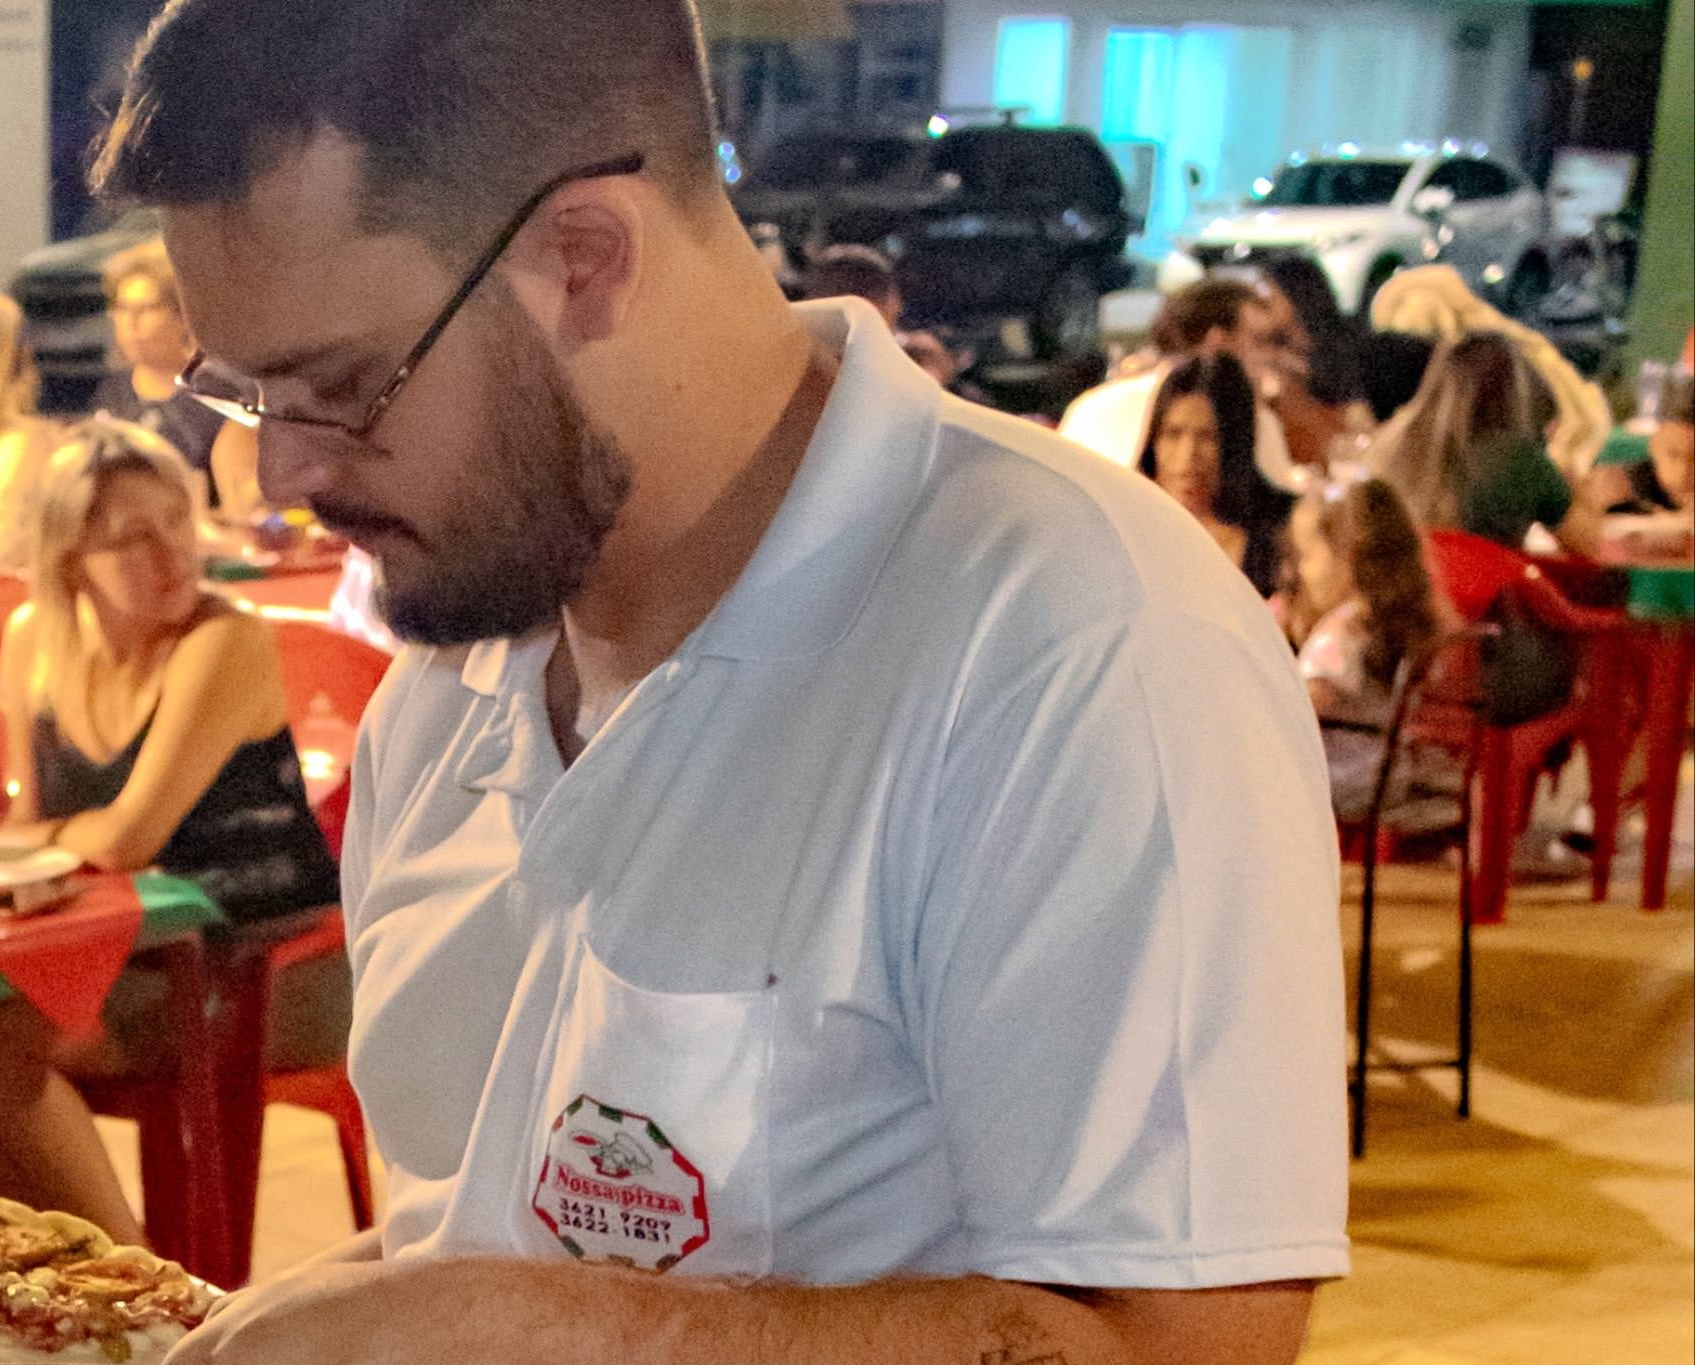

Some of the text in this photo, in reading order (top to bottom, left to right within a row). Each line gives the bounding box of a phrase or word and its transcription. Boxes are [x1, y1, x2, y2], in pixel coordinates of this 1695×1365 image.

[557, 1165, 684, 1214] Nossa pizza
[560, 1198, 606, 1219] 3621
[560, 1215, 609, 1235] 3622
